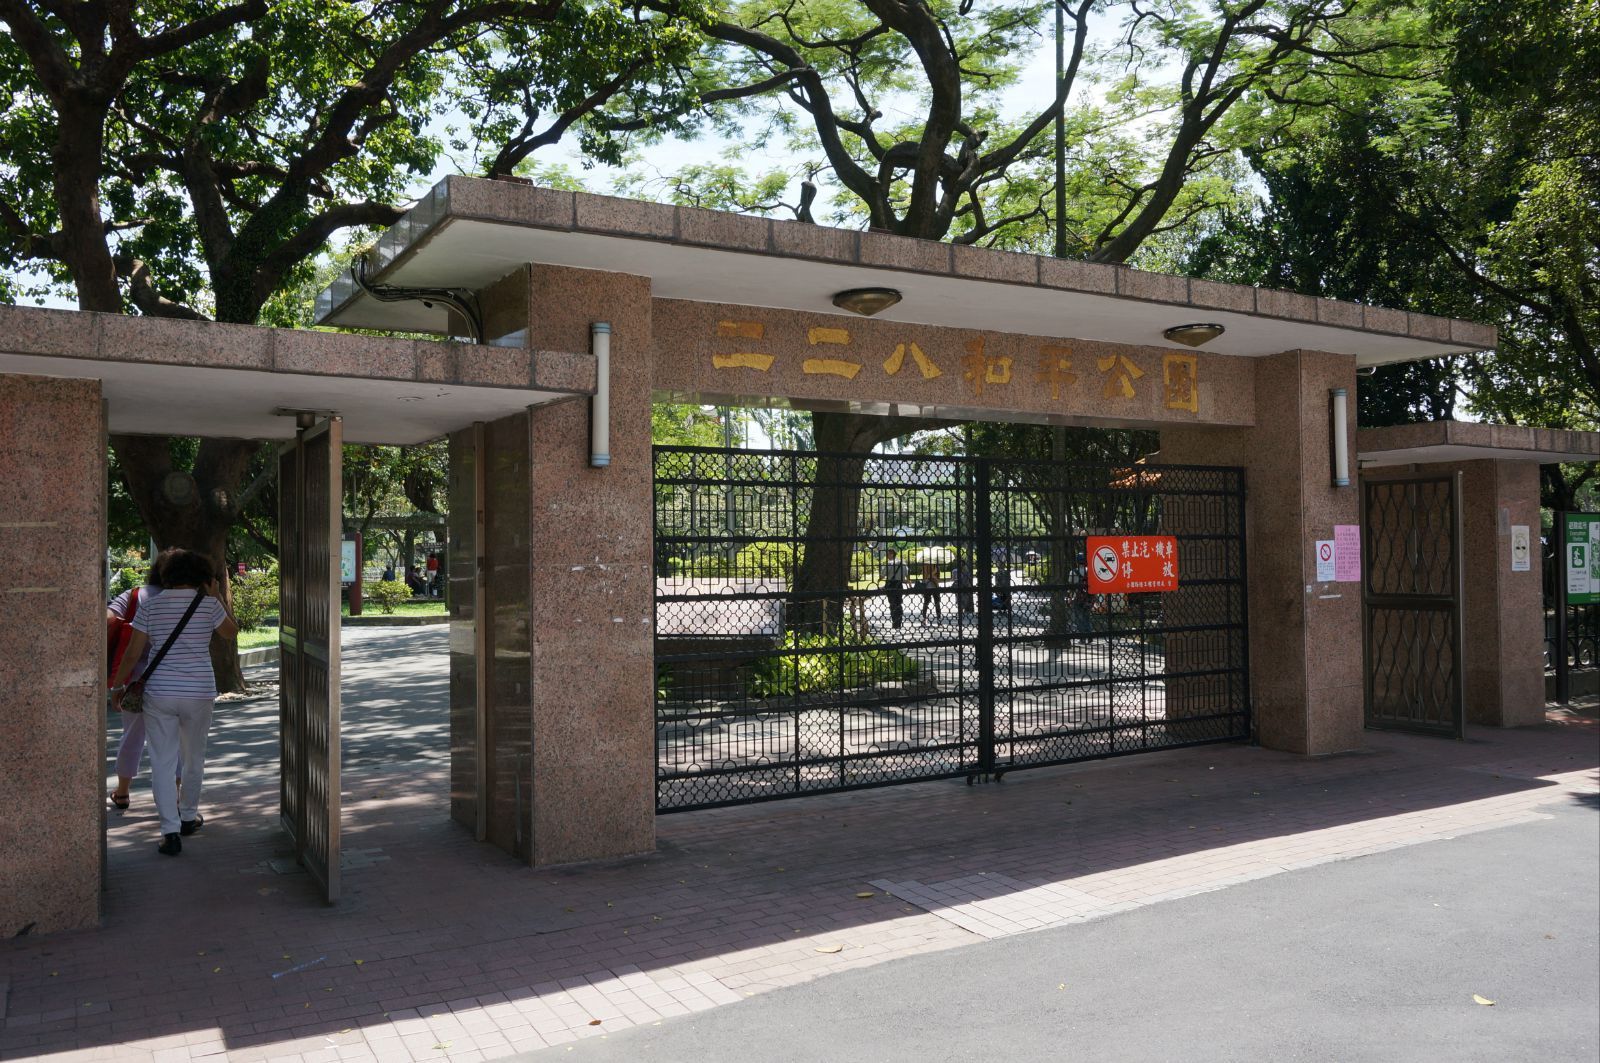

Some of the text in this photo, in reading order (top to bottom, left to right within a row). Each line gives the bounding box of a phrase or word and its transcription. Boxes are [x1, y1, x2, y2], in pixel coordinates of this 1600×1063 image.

[712, 319, 1199, 413] 二二八和平公園
